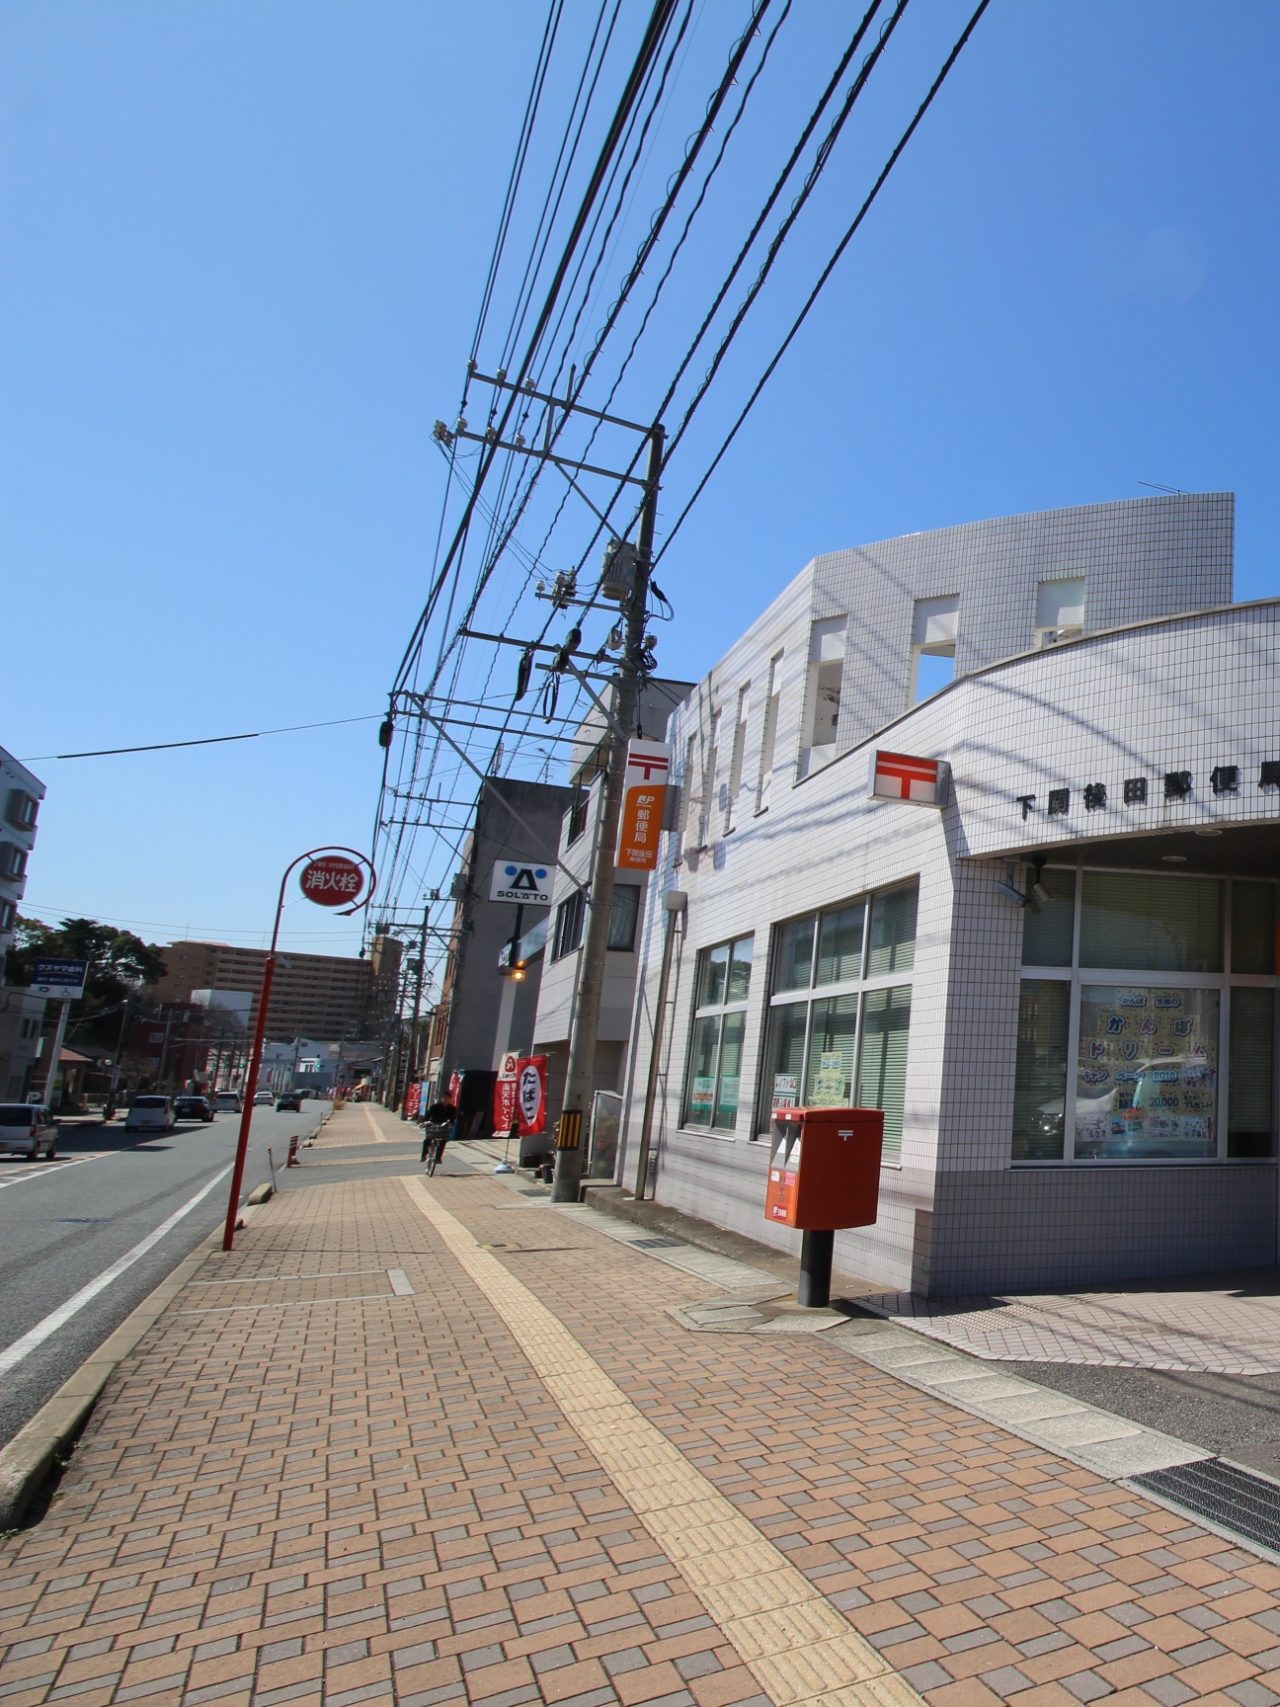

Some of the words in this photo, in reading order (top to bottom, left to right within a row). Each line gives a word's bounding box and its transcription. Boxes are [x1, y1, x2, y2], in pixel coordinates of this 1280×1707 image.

[634, 809, 650, 843] 郵便局
[305, 869, 359, 893] 消火栓
[496, 890, 549, 901] SOLATO
[522, 1071, 537, 1120] たばこ
